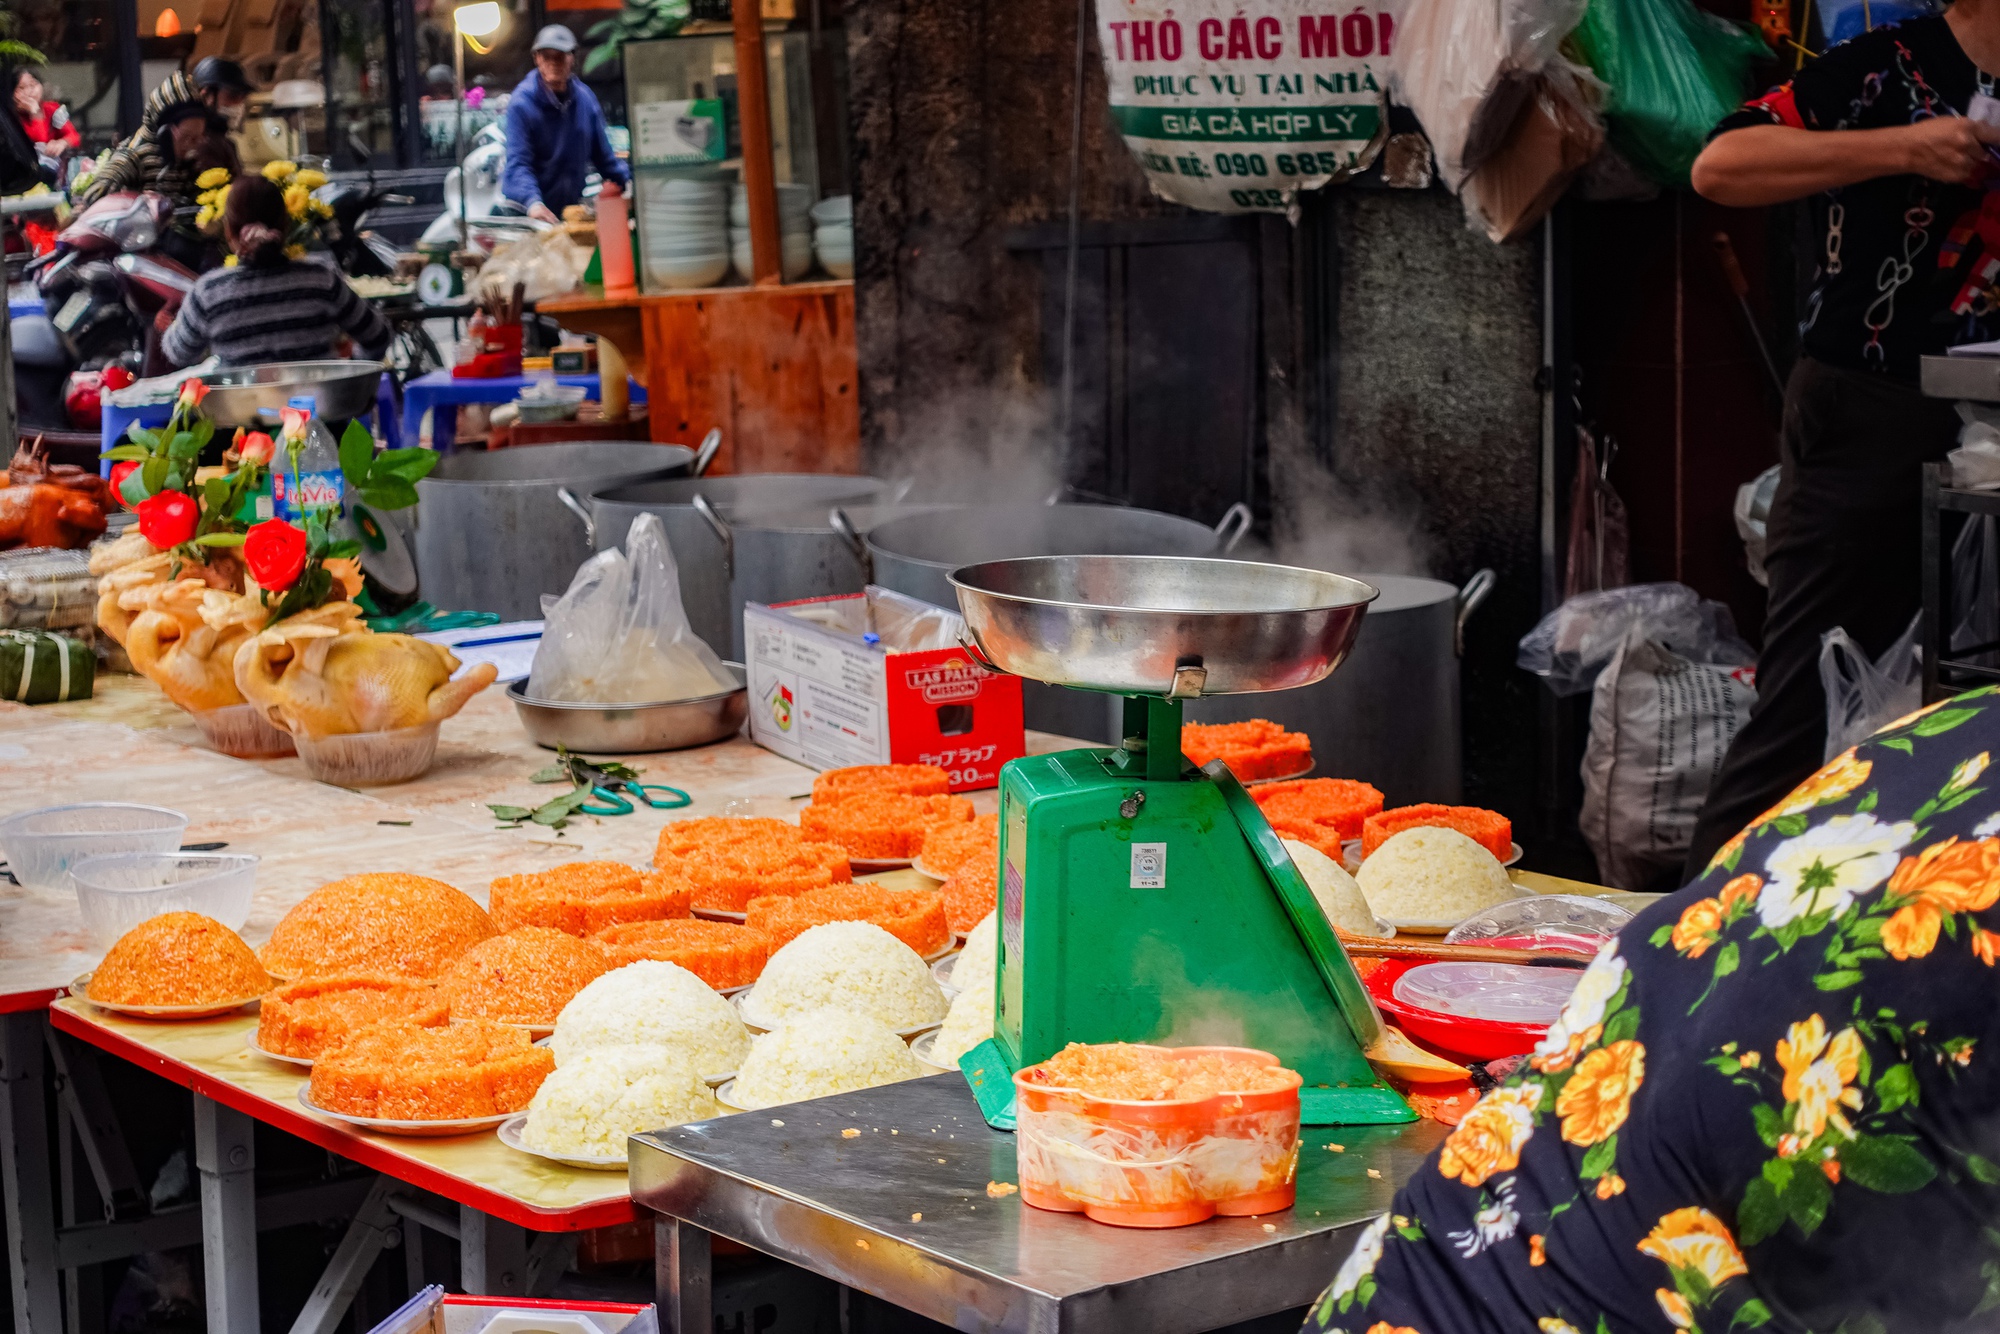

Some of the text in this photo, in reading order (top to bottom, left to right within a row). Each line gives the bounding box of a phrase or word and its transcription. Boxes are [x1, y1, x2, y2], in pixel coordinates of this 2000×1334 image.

[1199, 9, 1281, 60] CÁC
[1134, 64, 1380, 102] PHỤC VỤ TẠI NHÀ
[1215, 152, 1268, 176] 090
[1277, 151, 1336, 175] 685
[913, 671, 941, 685] LAS
[930, 682, 976, 696] MISSION
